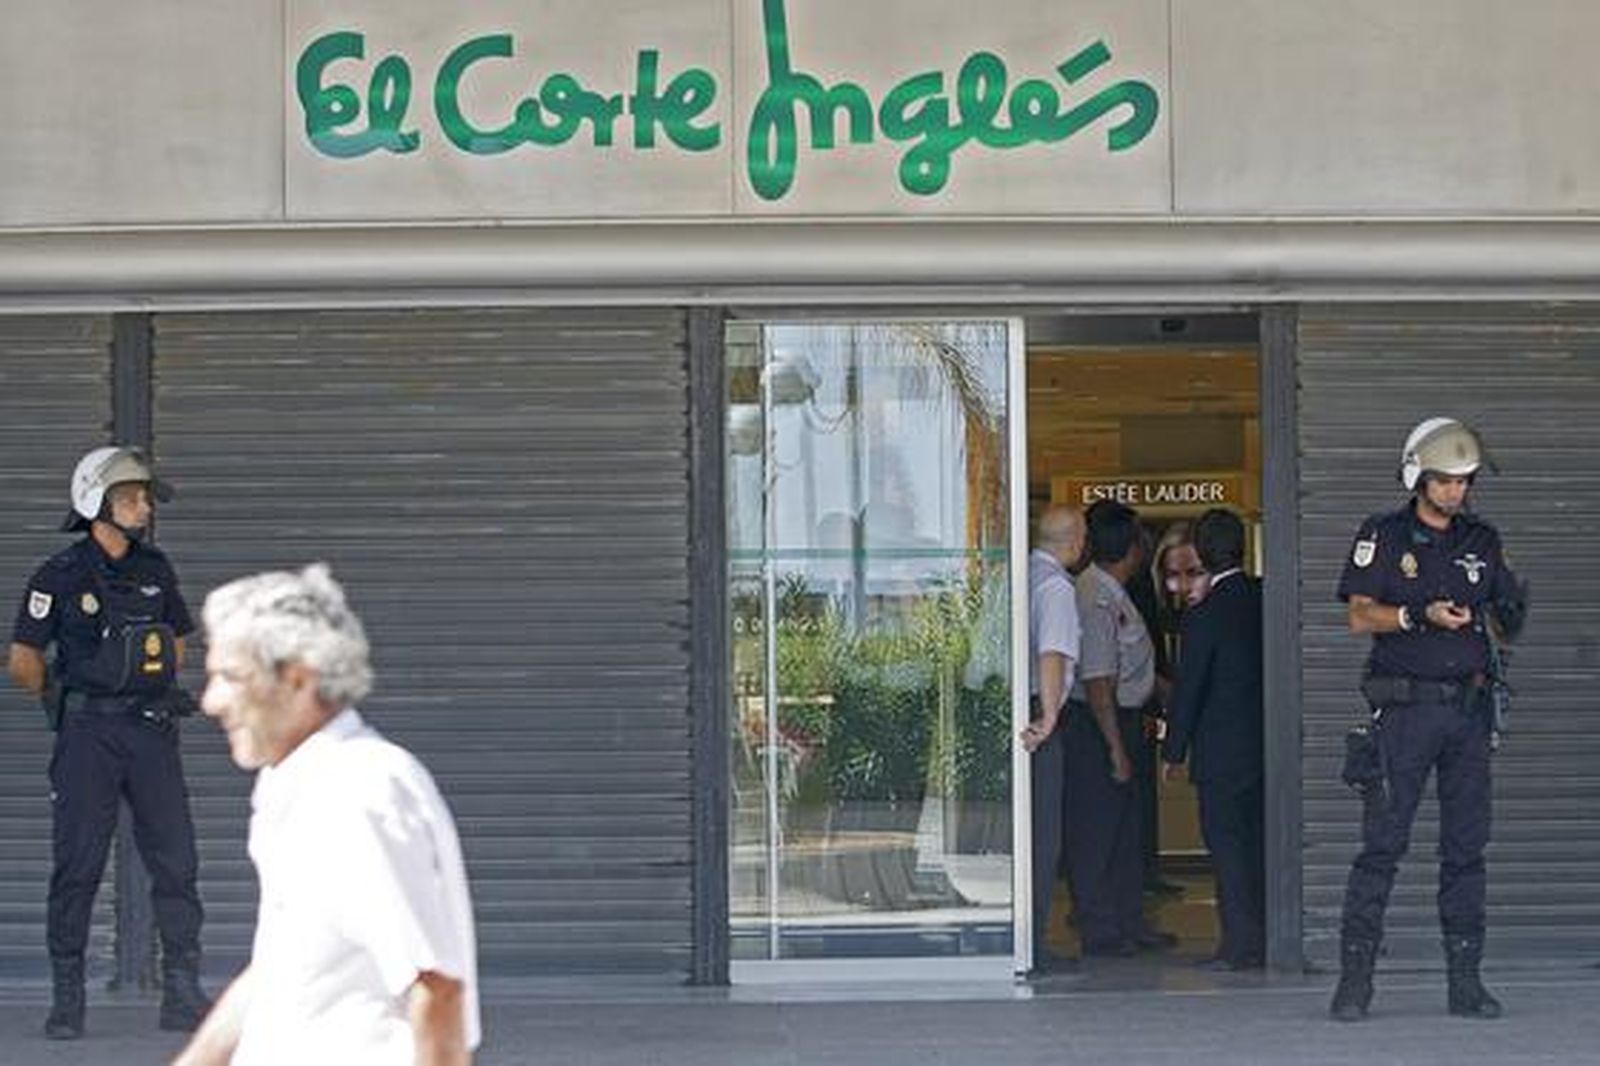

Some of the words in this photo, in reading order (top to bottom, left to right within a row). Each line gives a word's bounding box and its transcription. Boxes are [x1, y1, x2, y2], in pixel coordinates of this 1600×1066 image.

[294, 30, 421, 158] El
[433, 33, 722, 154] Corte
[747, 0, 1160, 201] Inglés
[1144, 481, 1226, 503] LAUDER
